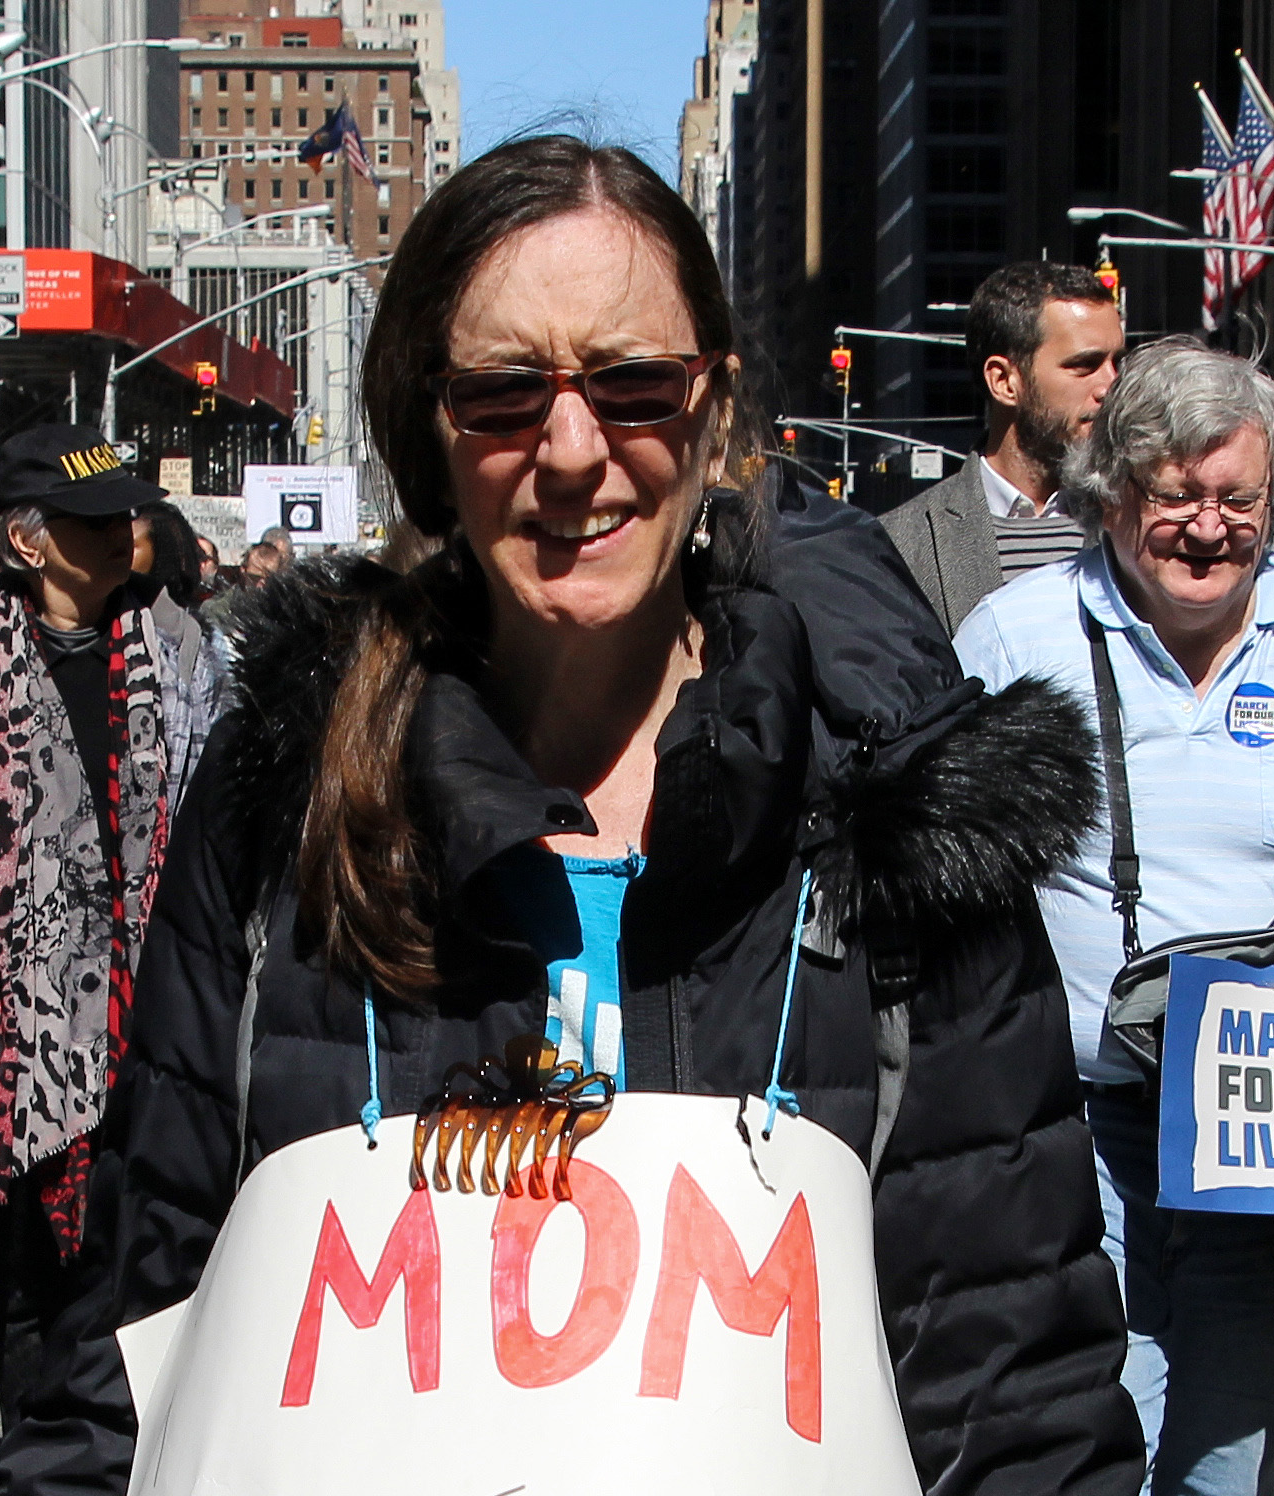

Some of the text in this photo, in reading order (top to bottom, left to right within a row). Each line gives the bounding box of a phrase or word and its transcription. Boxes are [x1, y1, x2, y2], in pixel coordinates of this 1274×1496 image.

[162, 461, 190, 472] STOP
[1234, 700, 1269, 711] MARCH
[1234, 710, 1274, 720] FOR OUR
[281, 1157, 822, 1443] MOM
